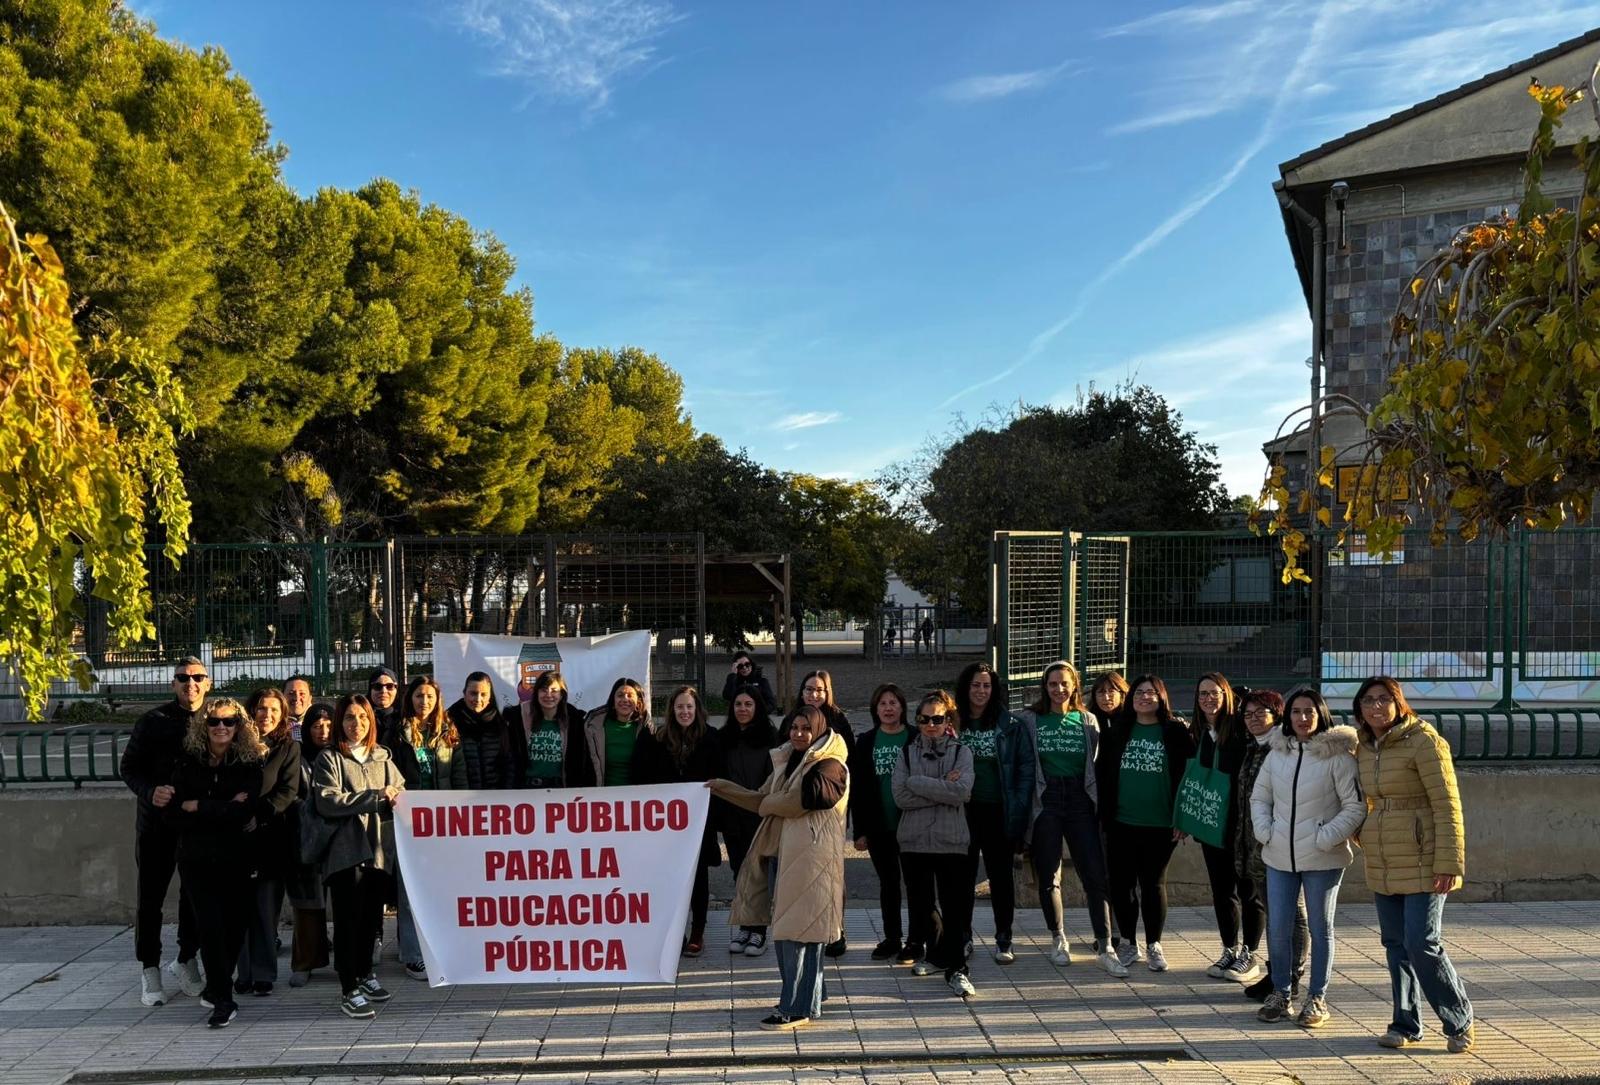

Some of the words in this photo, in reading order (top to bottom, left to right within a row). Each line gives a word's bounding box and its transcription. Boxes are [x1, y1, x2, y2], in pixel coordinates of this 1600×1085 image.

[411, 802, 536, 838] DINERO
[545, 796, 689, 835] PÚBLICO
[485, 848, 573, 881] PARA
[580, 847, 620, 879] LA
[457, 887, 650, 928] EDUCACIÓN
[484, 935, 628, 972] PÚBLICA
